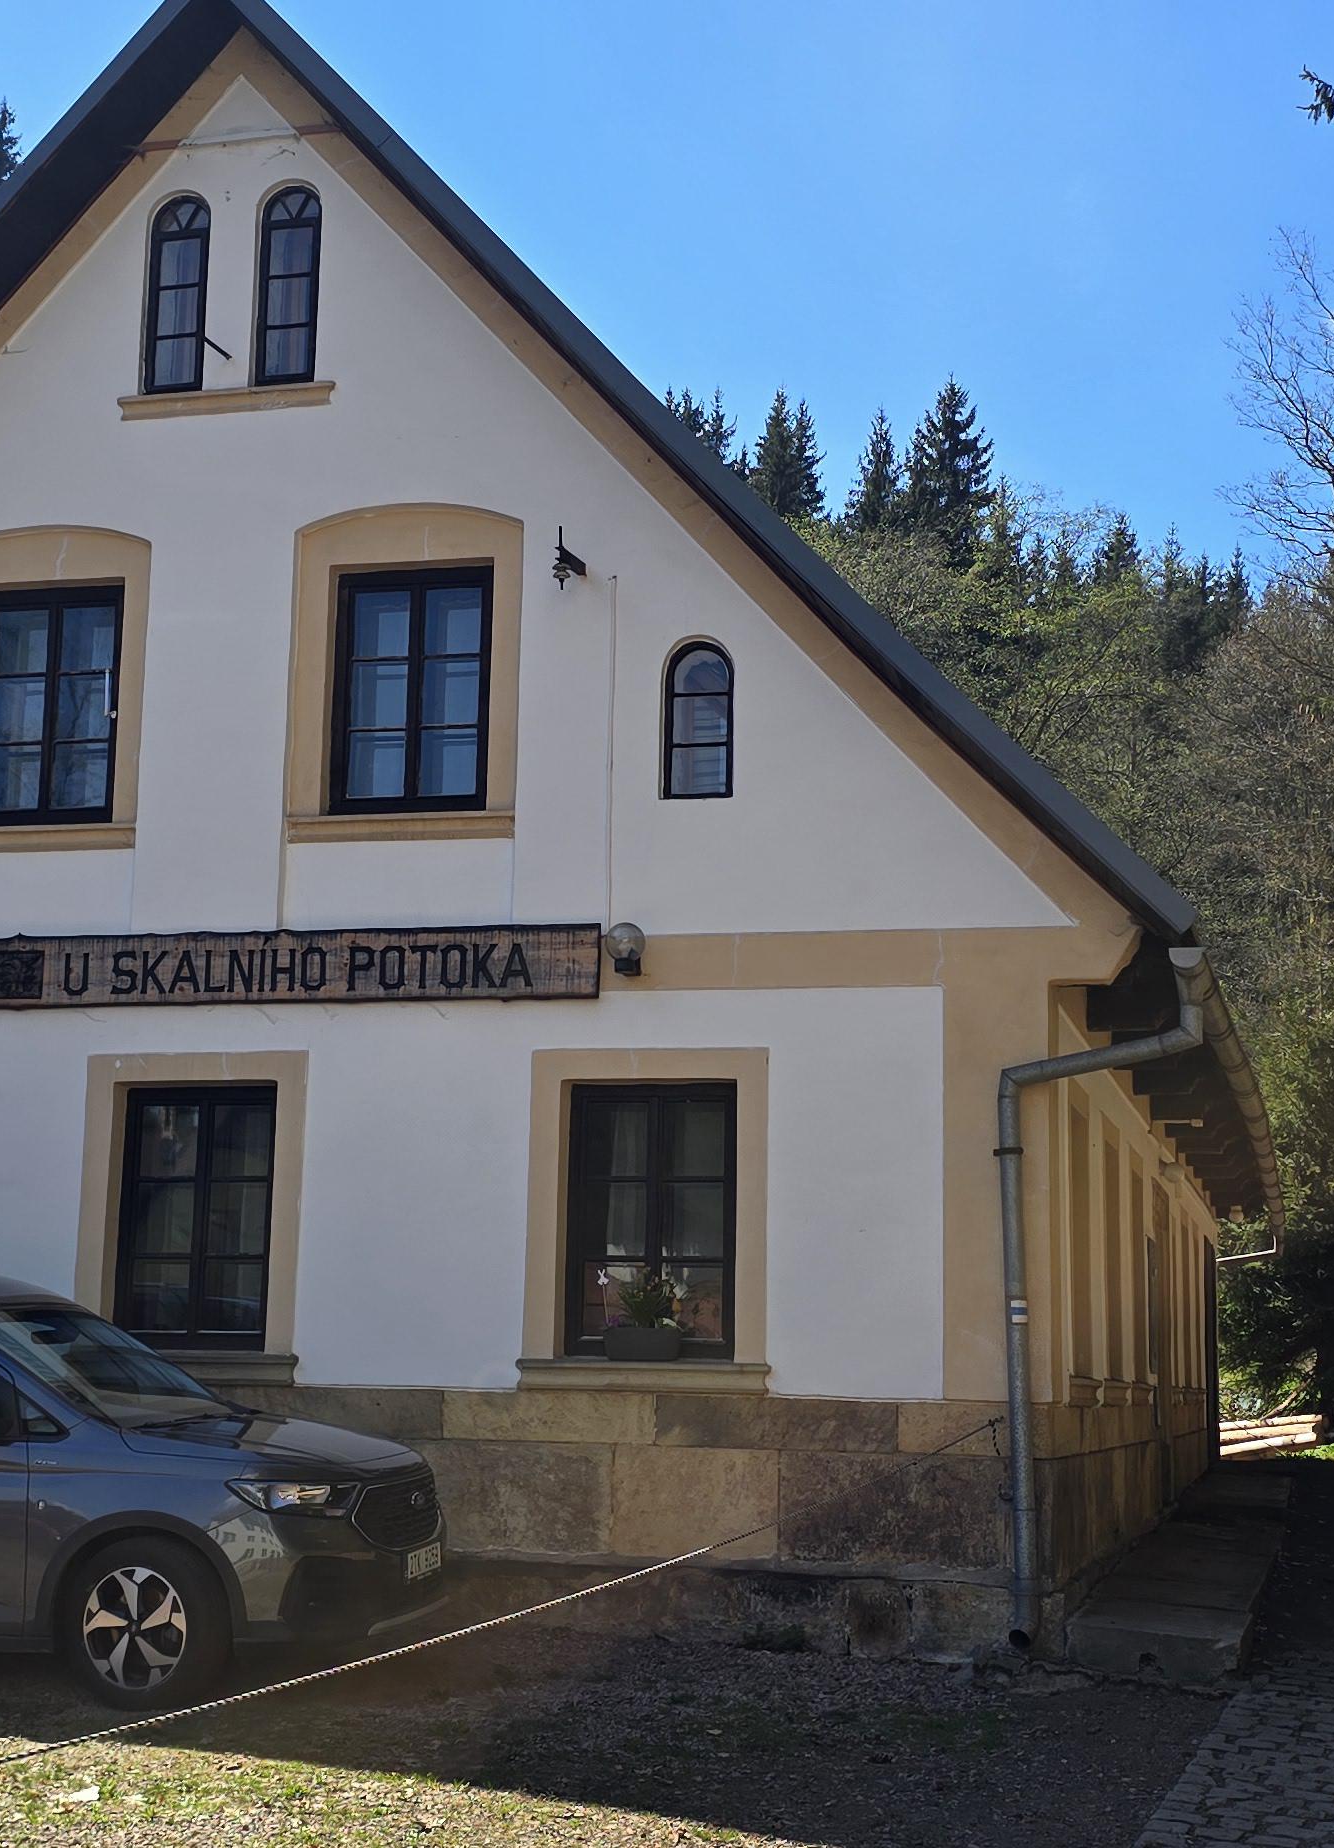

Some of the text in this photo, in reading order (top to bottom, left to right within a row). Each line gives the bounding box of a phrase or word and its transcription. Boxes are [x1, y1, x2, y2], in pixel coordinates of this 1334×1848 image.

[63, 936, 534, 996] U SKALNÍHO POTOKA
